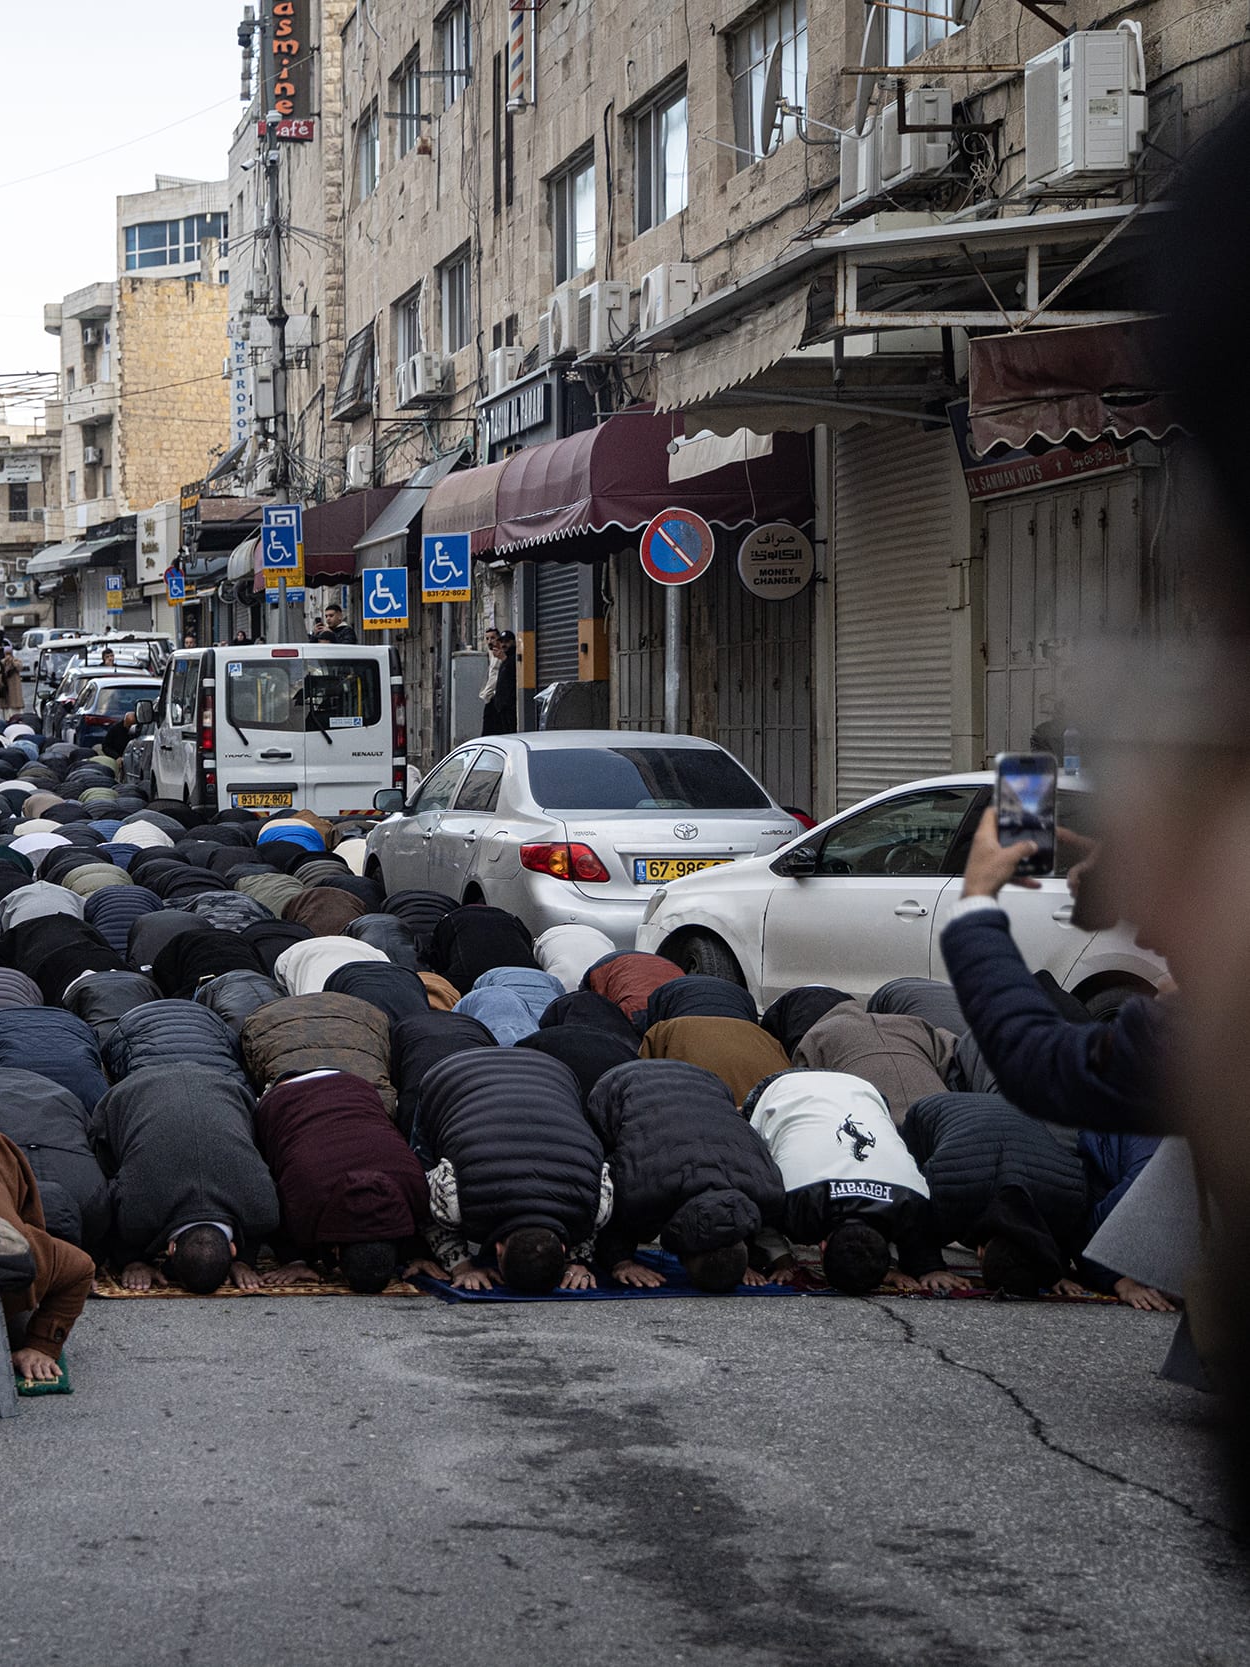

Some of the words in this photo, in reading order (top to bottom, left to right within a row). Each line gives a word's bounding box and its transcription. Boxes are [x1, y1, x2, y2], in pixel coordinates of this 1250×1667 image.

[276, 120, 309, 137] afé
[1017, 463, 1042, 483] NUTS
[759, 568, 794, 576] MONEY
[753, 577, 801, 585] CHANGER
[830, 1181, 893, 1202] Ferrari
